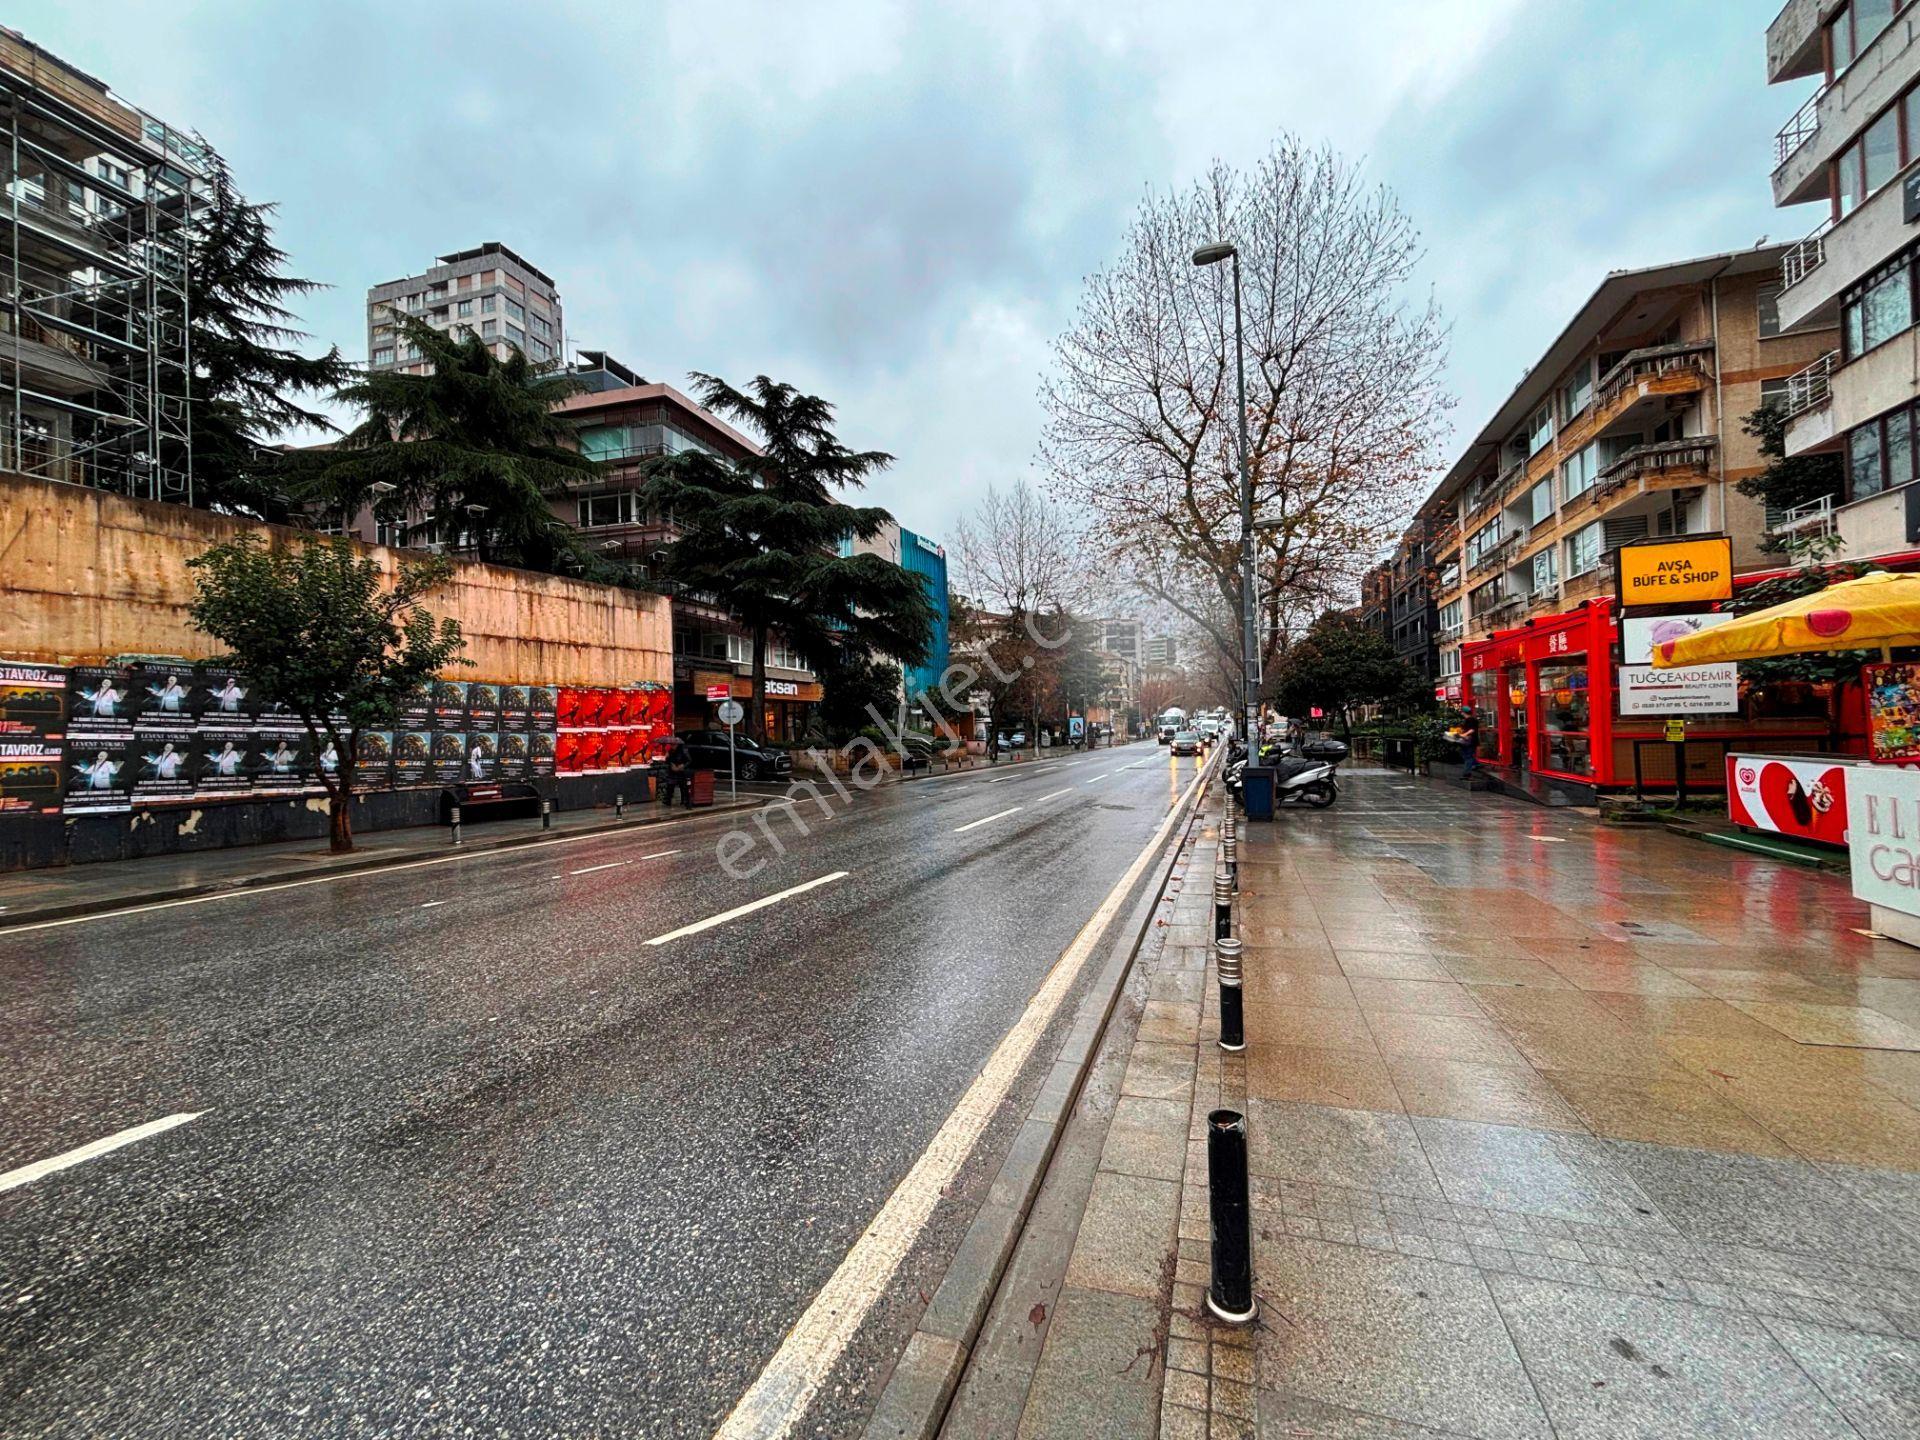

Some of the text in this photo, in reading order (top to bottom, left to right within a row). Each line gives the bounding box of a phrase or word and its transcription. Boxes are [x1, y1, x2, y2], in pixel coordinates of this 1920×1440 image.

[1657, 560, 1692, 573] AVŞA
[1633, 571, 1719, 587] BÜFE & SHOP
[764, 680, 798, 695] atsan
[0, 743, 43, 756] TAVROZ
[1865, 794, 1920, 842] EL
